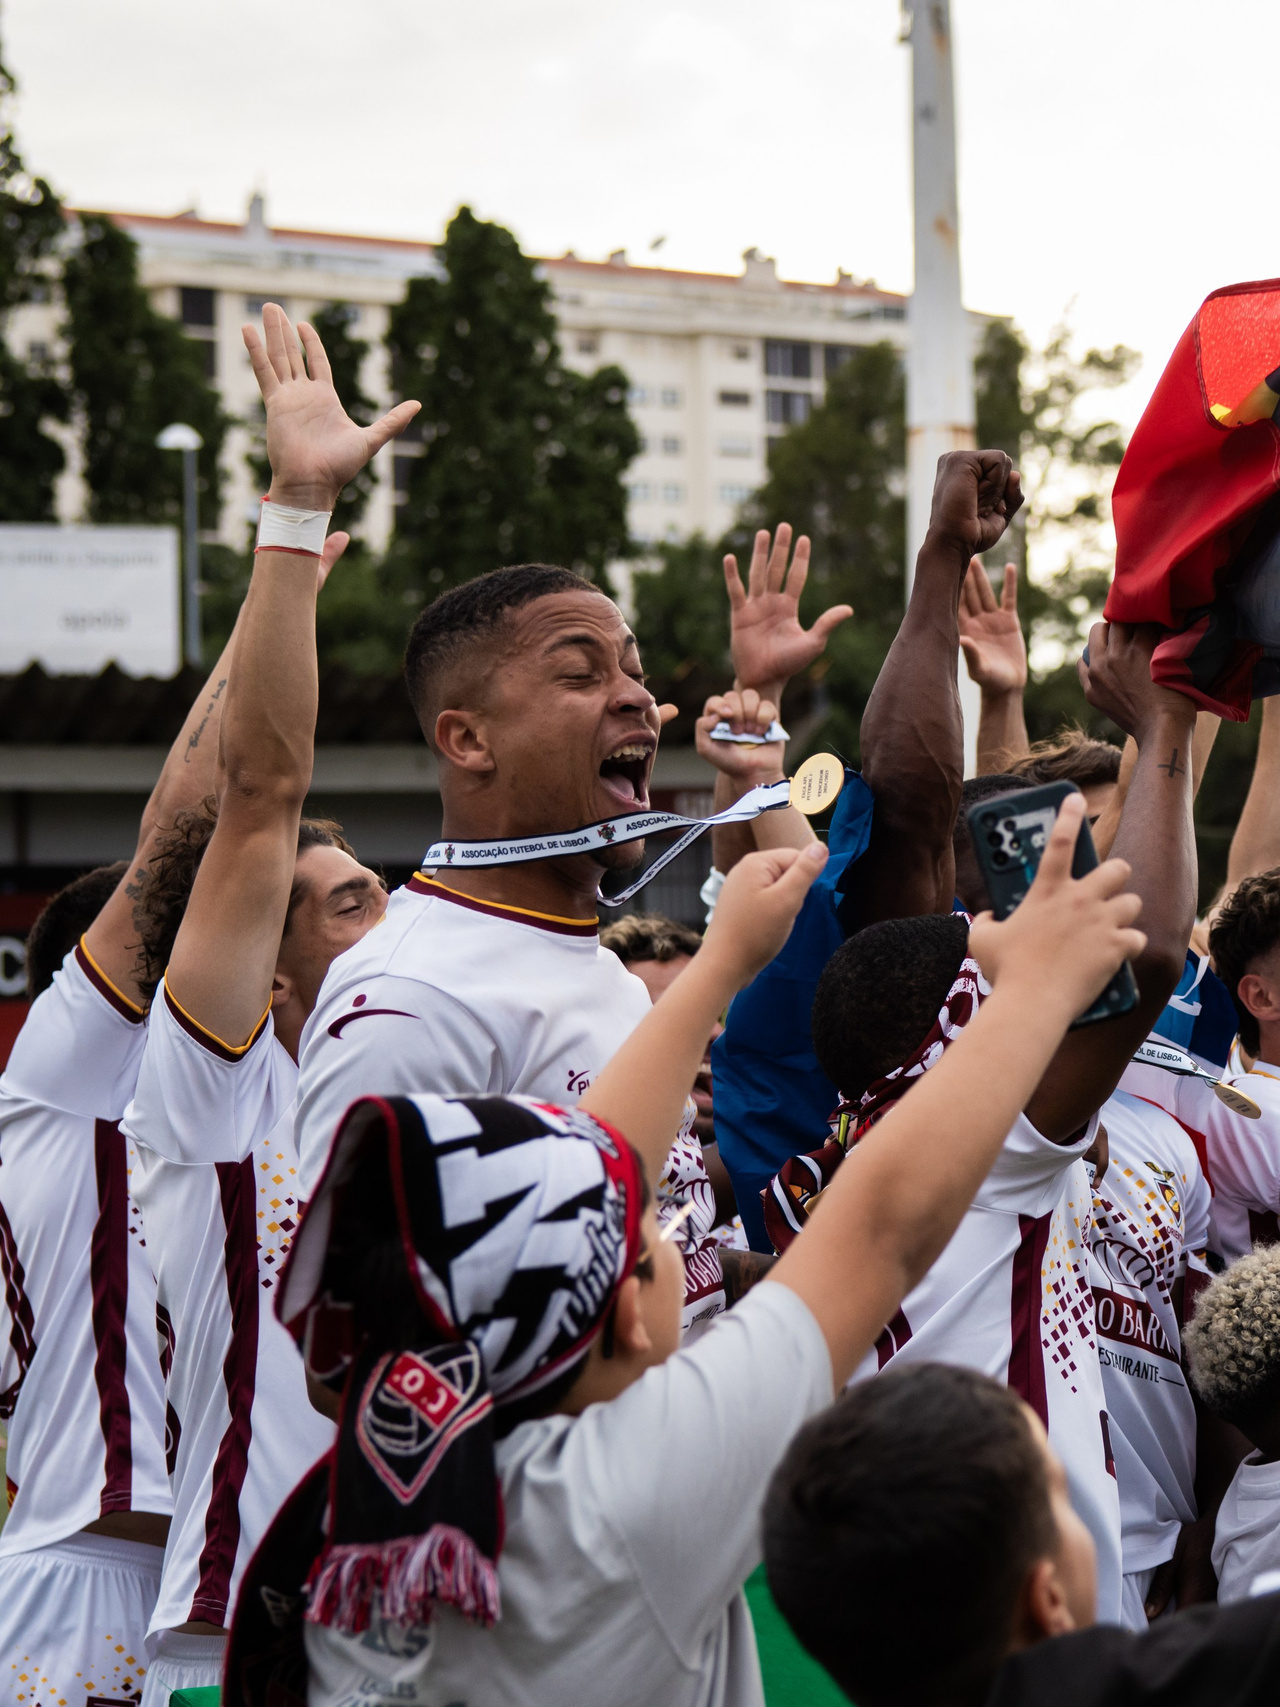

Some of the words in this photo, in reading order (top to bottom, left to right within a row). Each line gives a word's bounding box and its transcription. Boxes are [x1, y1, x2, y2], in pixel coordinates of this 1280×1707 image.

[461, 846, 509, 859] ASSOCIAÇÃO
[510, 842, 546, 856] FUTEBOL
[548, 840, 559, 850] DE
[560, 836, 591, 849] LISBOA
[1146, 1048, 1156, 1058] DE
[1156, 1051, 1182, 1063] LISBOA
[1097, 1346, 1160, 1384] ESTAURANTE
